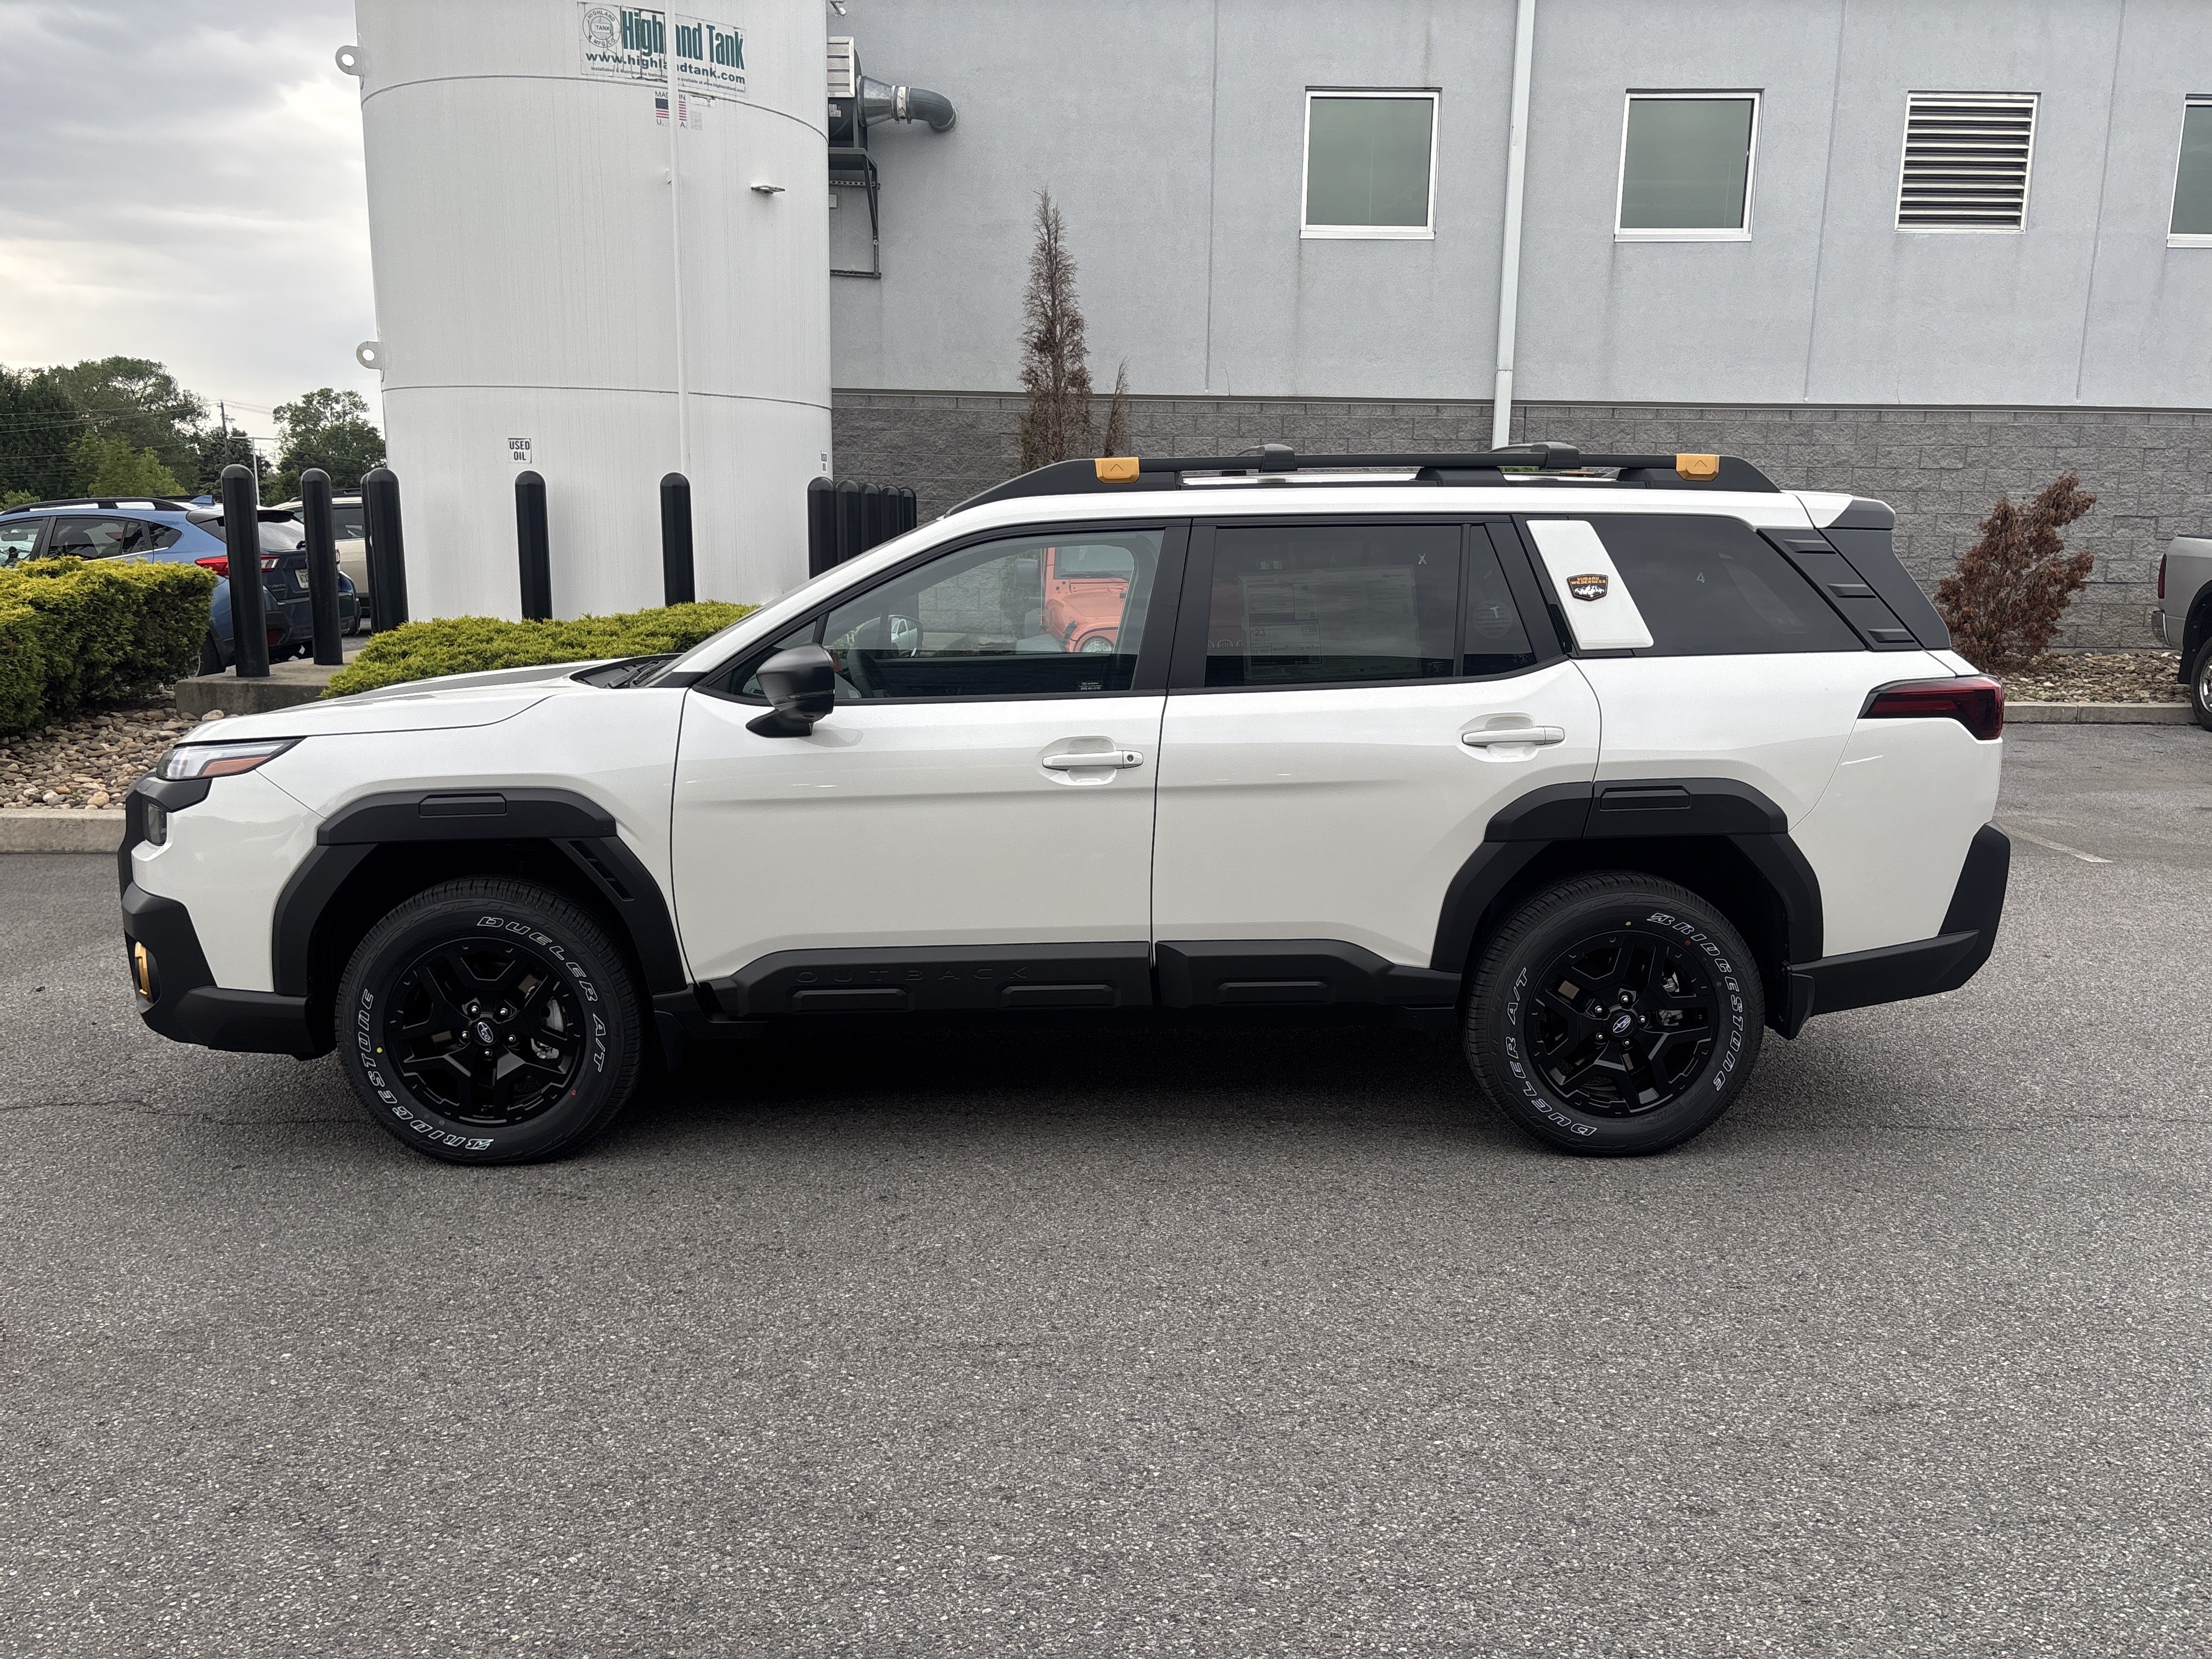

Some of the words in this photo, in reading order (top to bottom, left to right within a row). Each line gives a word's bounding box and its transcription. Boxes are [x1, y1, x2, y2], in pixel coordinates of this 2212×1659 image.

[587, 10, 615, 21] HIGHLAND
[622, 10, 703, 61] Highnd
[706, 24, 745, 70] Tank
[509, 441, 530, 450] USED
[514, 451, 527, 461] OIL
[477, 916, 598, 1002] DUELER
[593, 1013, 606, 1073] A/T
[795, 966, 1028, 983] OUTBACK
[1507, 967, 1528, 1025] A/T
[1646, 913, 1743, 1091] BRIDGESTONE
[358, 989, 494, 1150] BRIDGESTONE
[1505, 1036, 1597, 1137] DUELER
